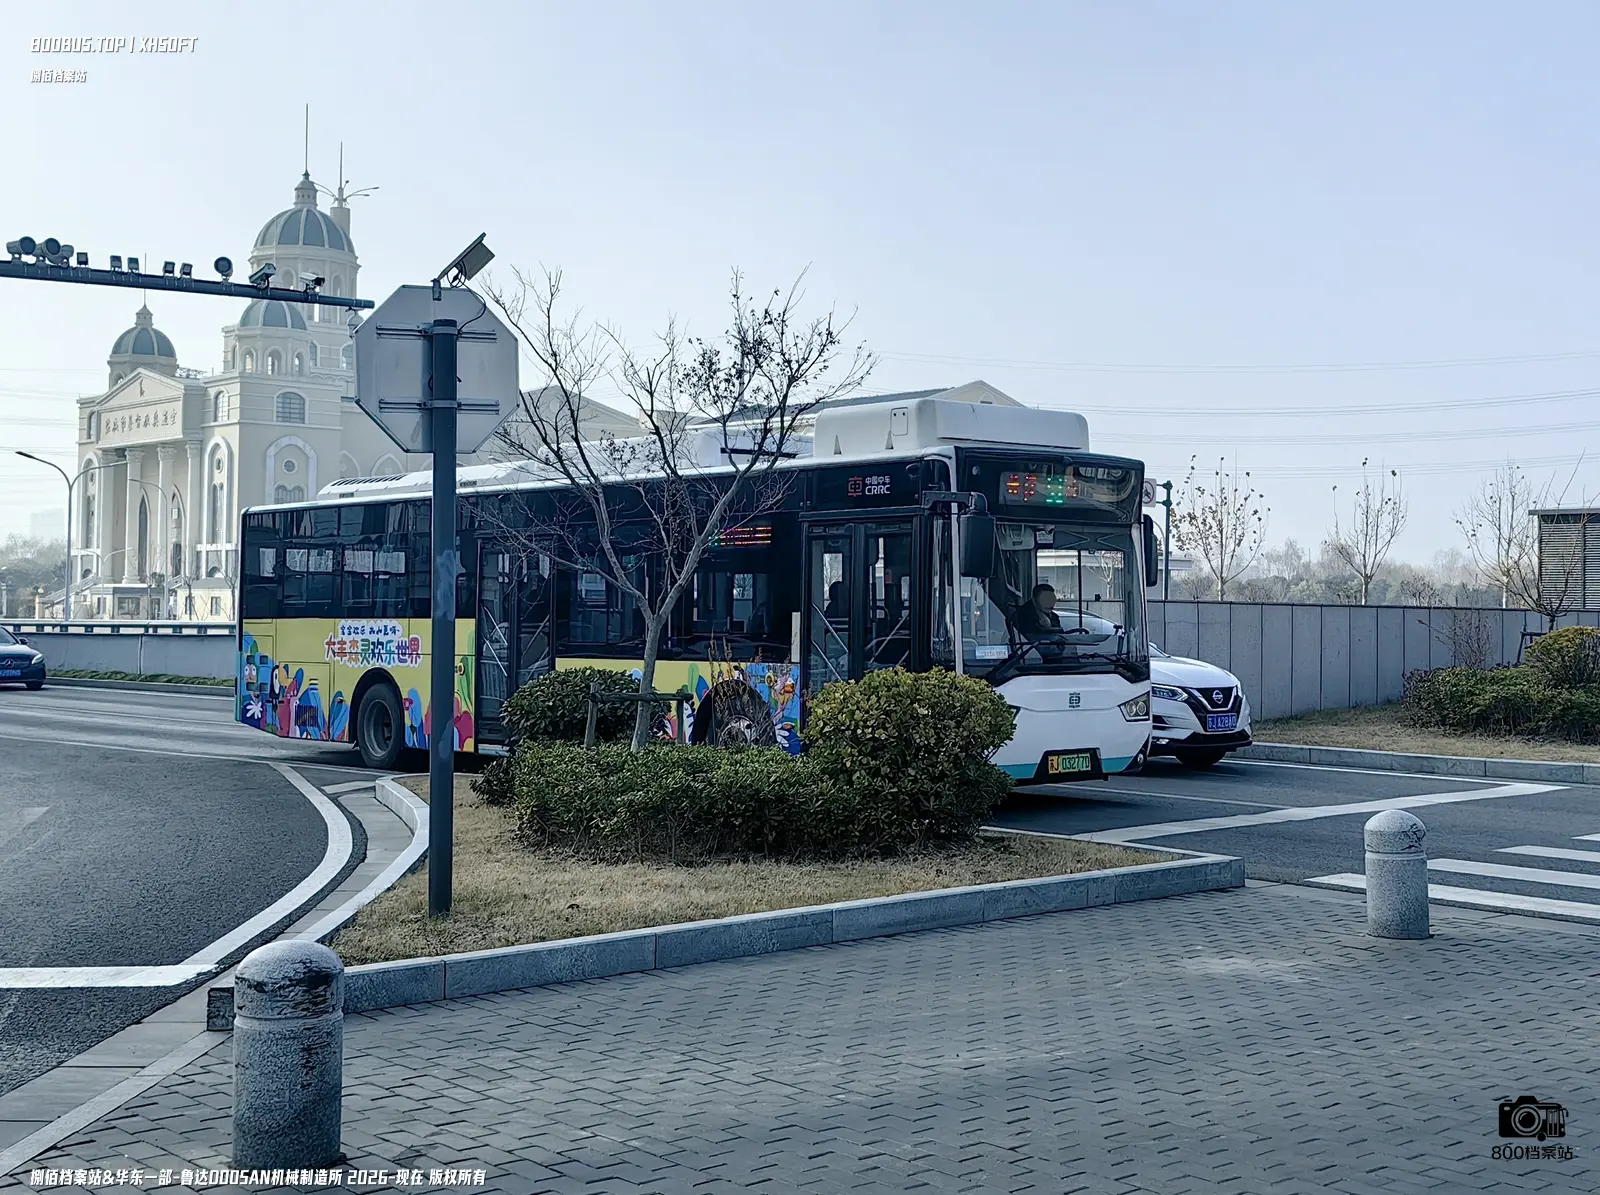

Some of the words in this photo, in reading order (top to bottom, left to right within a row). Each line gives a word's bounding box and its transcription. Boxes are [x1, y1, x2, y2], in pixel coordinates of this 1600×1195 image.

[865, 476, 890, 485] 中国中车
[865, 485, 890, 495] CRRC
[325, 635, 421, 665] 大丰森灵欢乐世界
